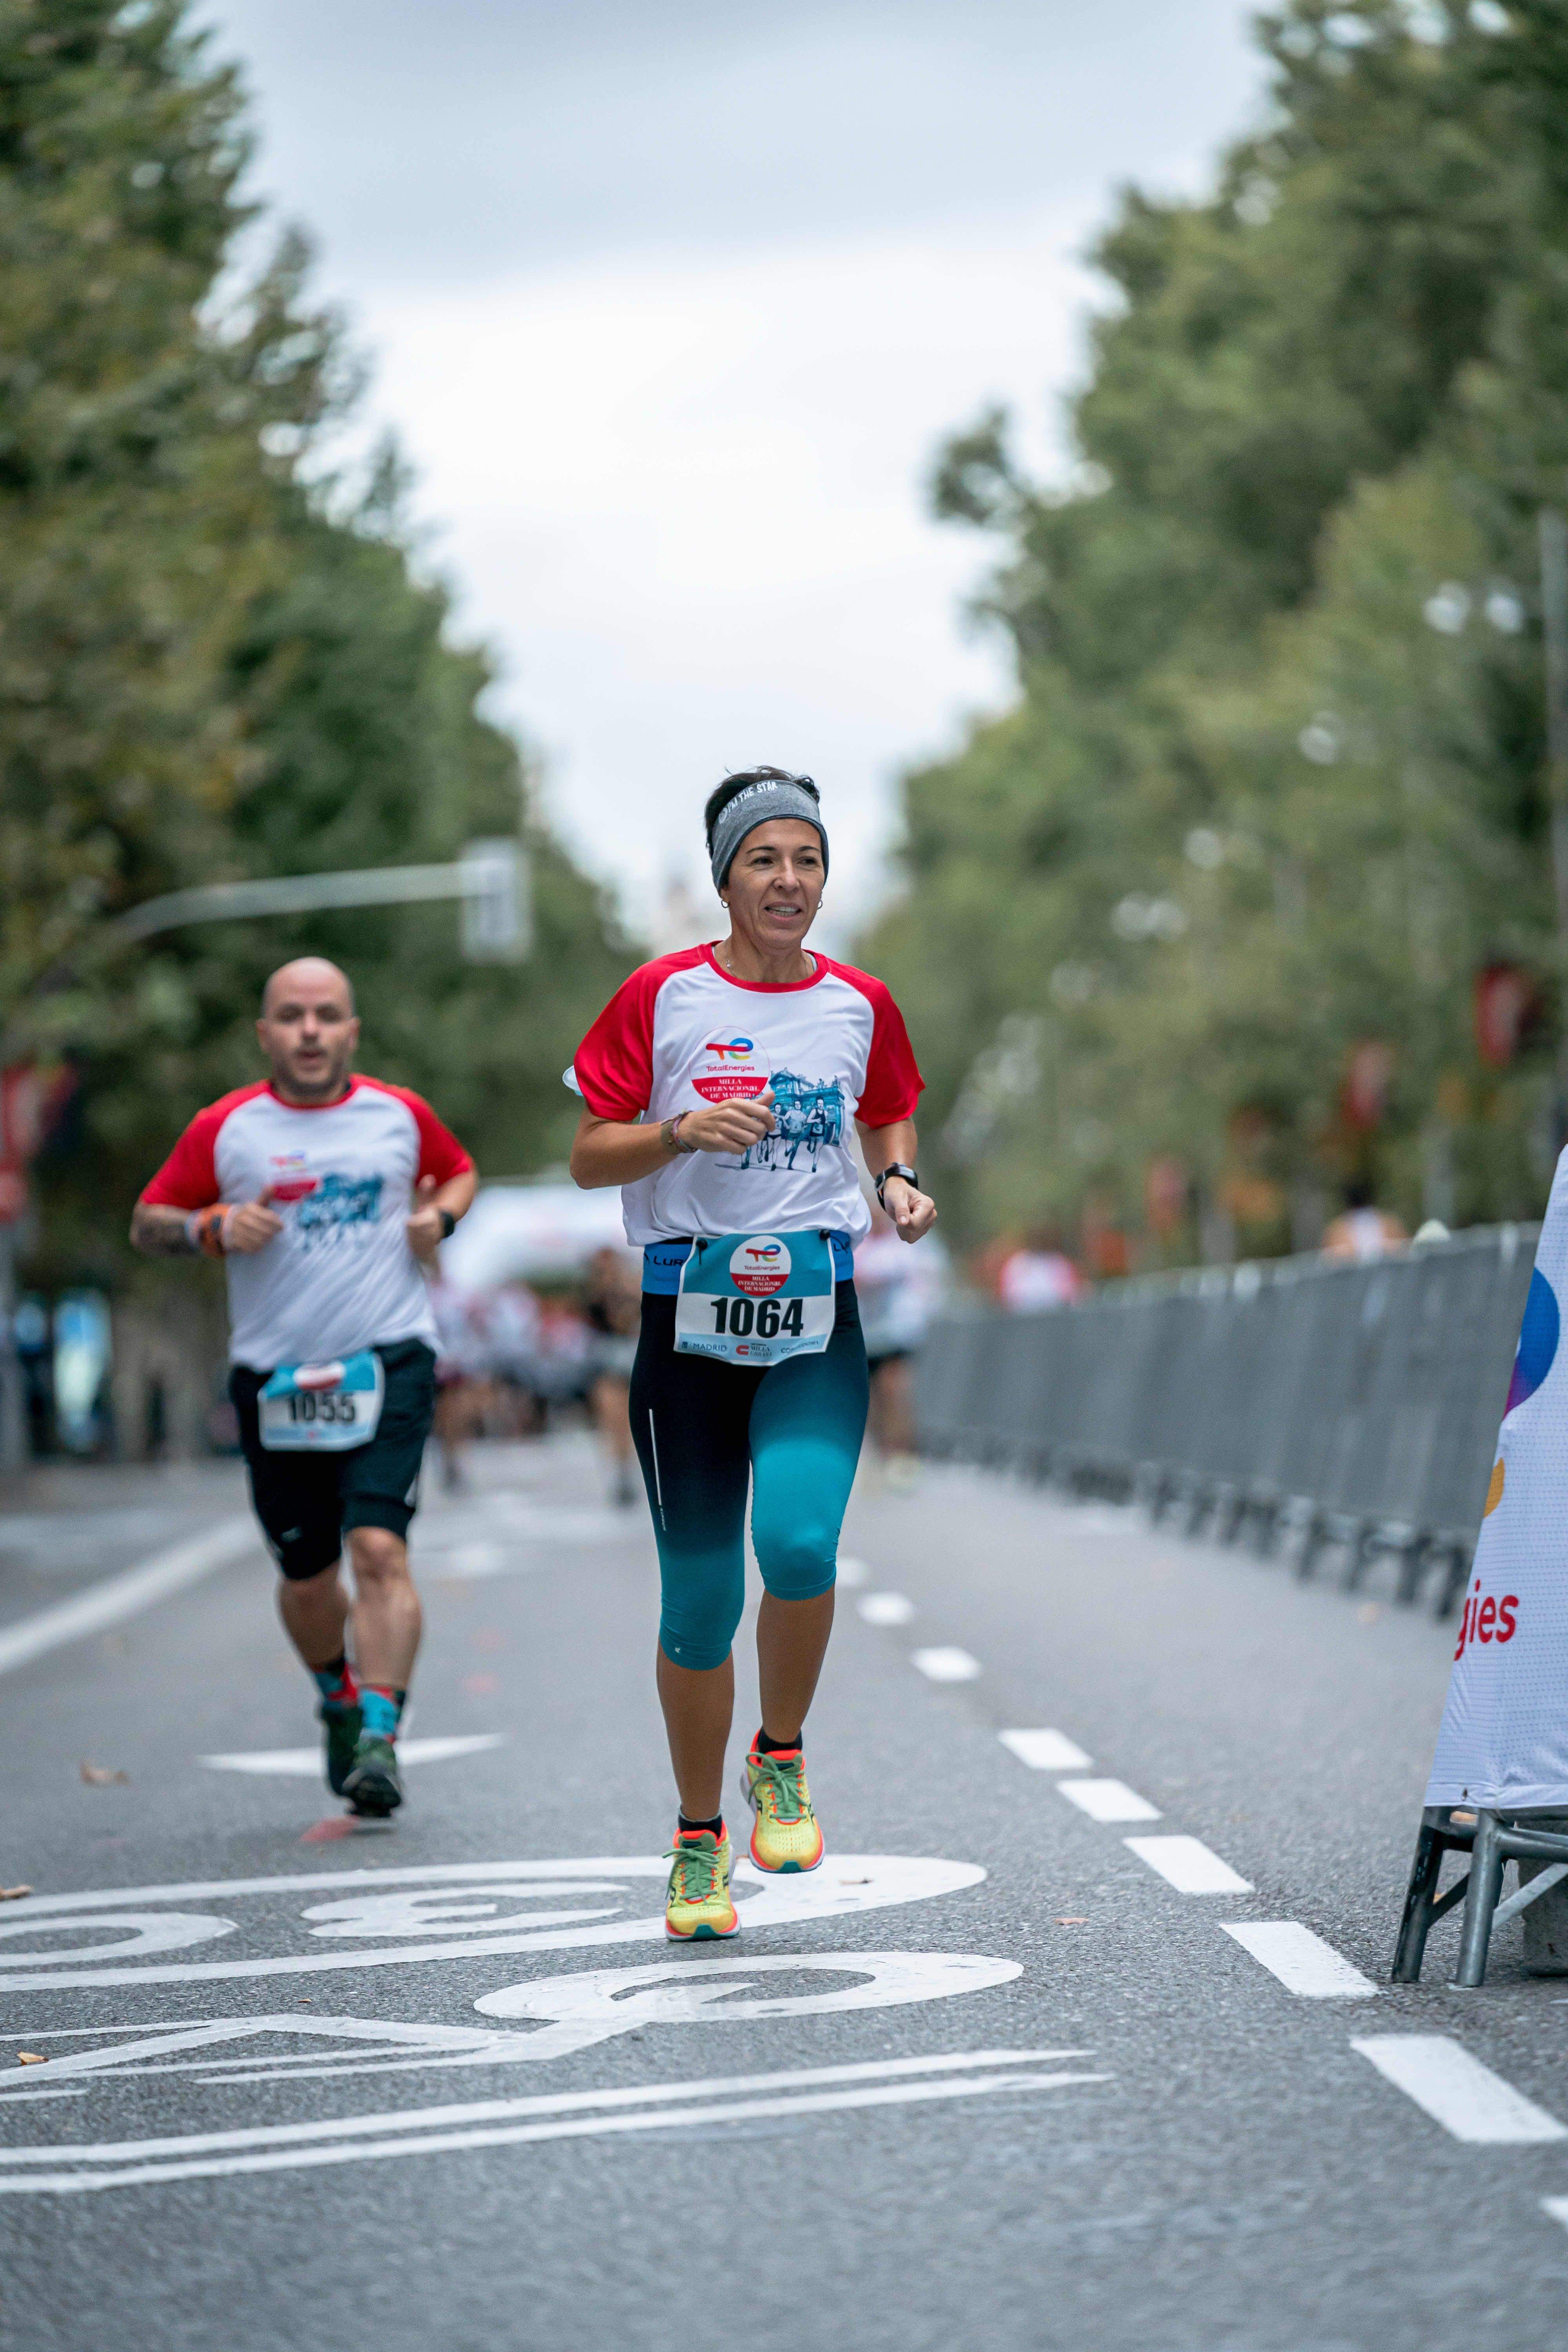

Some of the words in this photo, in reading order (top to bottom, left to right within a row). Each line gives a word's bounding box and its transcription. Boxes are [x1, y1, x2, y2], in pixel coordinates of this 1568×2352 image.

[738, 787, 754, 802] THE
[710, 1297, 804, 1338] 1064
[693, 1342, 727, 1352] MADRID
[287, 1390, 356, 1422] 1055
